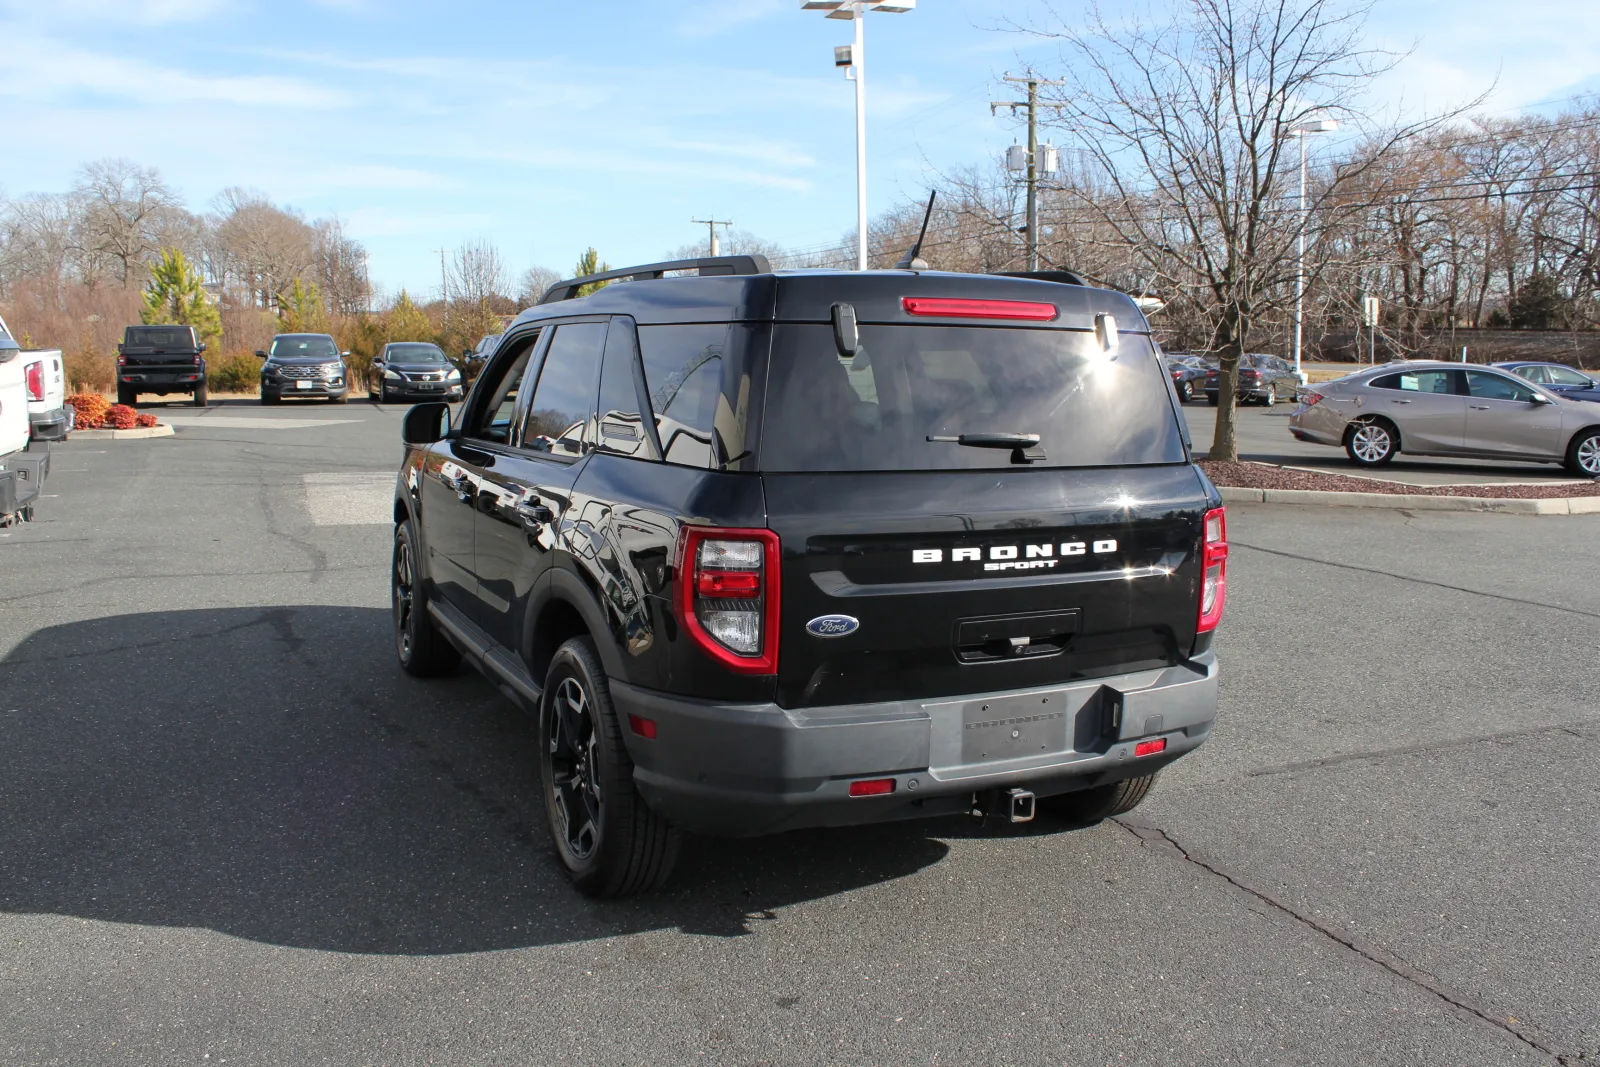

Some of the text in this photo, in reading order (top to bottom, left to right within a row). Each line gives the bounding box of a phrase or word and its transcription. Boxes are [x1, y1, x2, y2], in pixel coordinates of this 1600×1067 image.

[912, 539, 1117, 563] BRONCO
[984, 559, 1059, 571] SPORT
[819, 619, 848, 632] Ford
